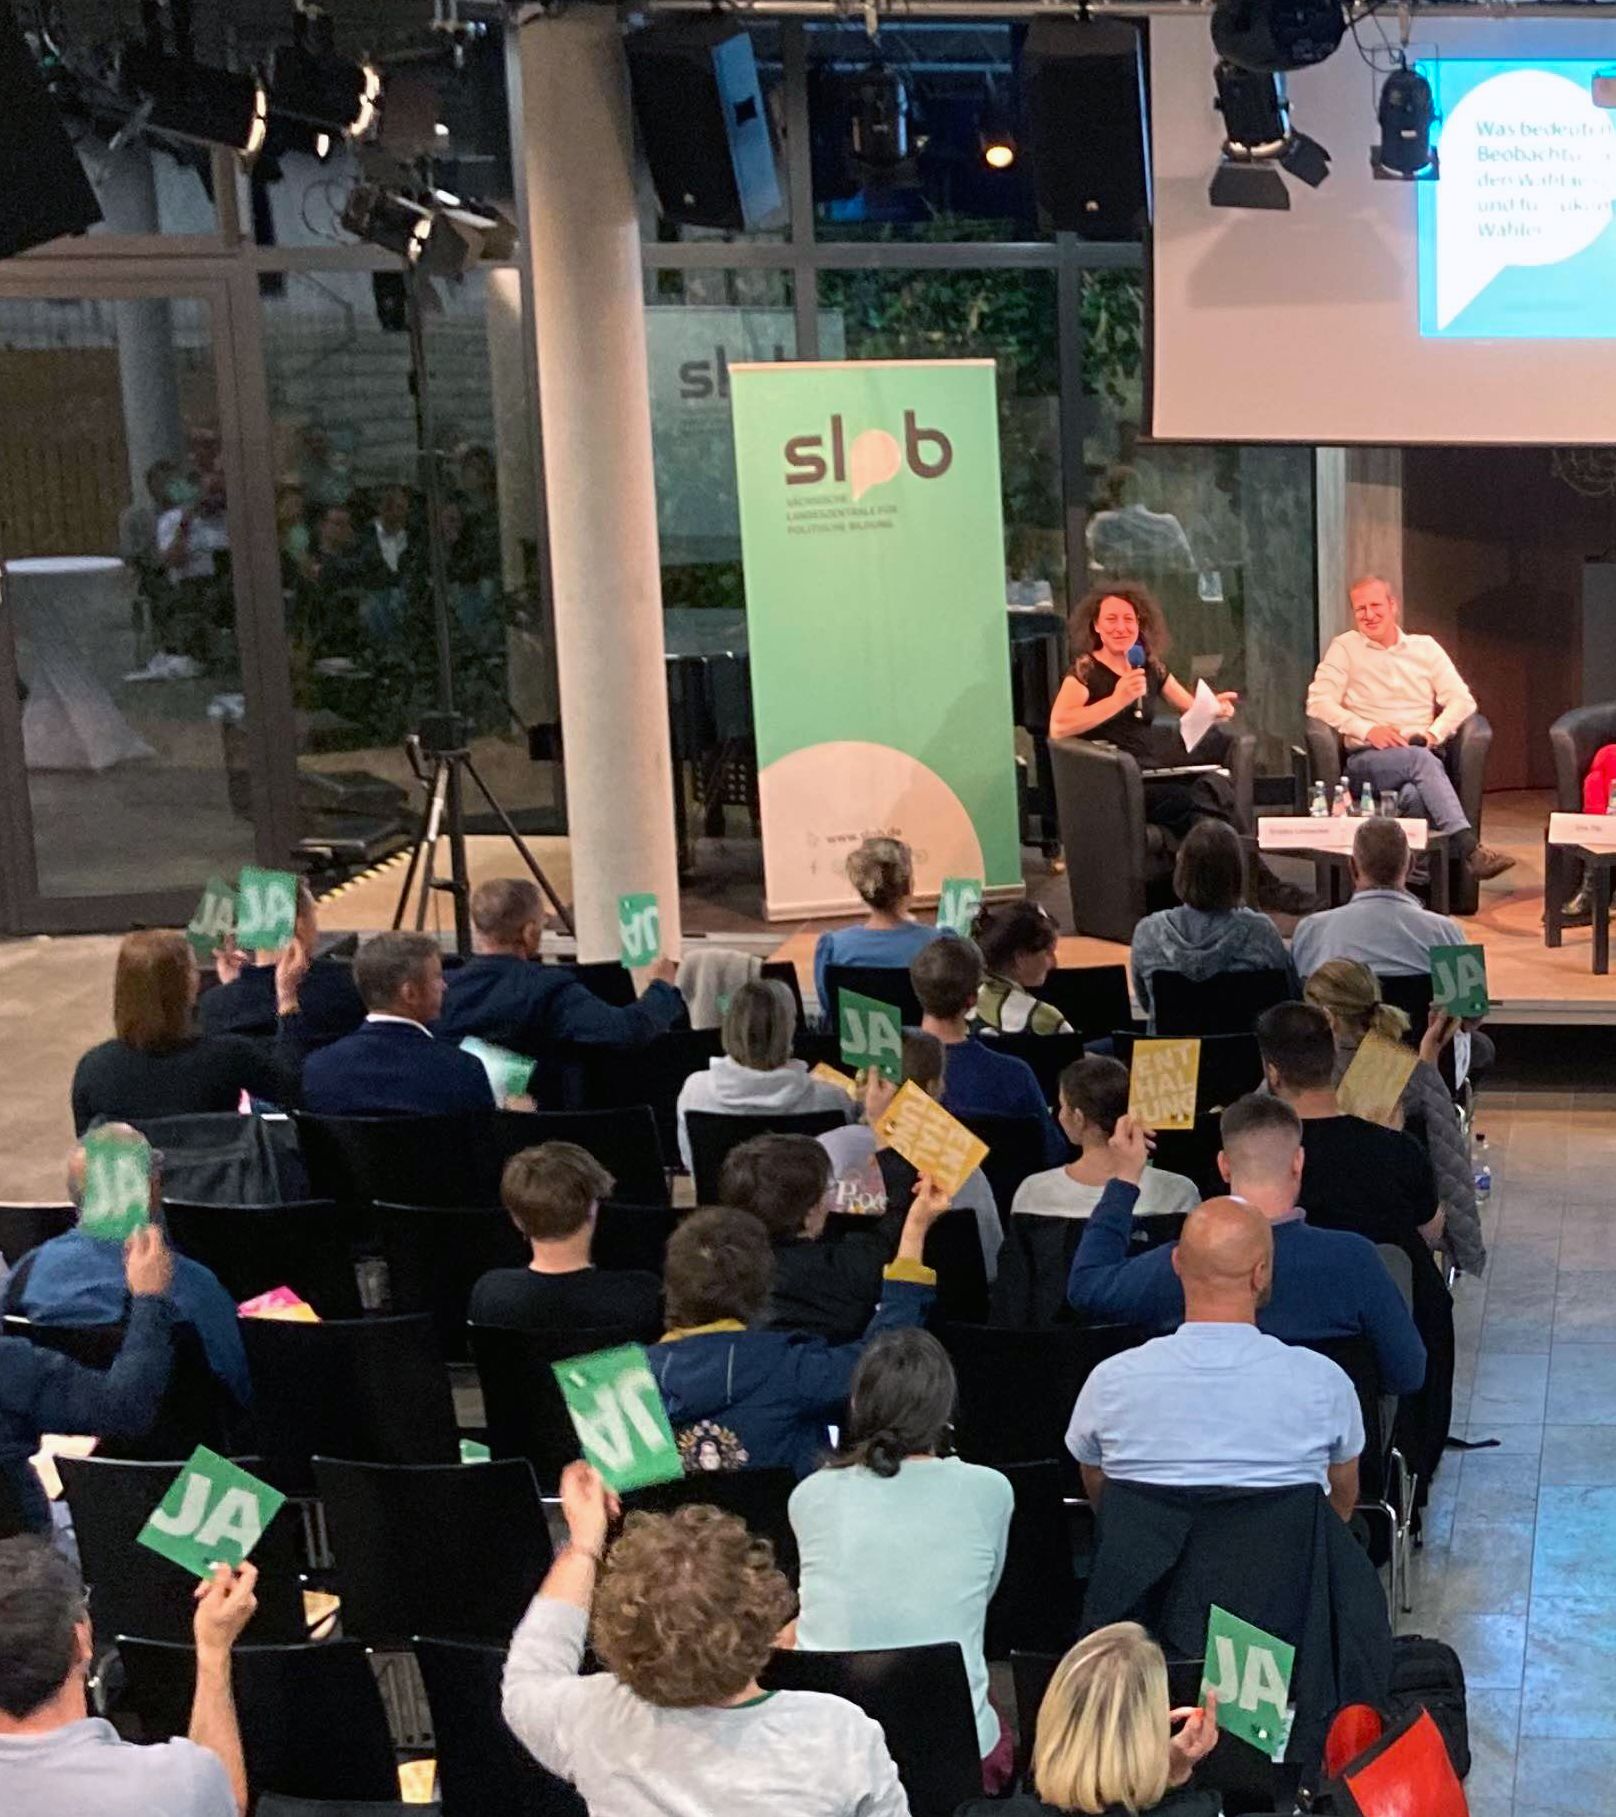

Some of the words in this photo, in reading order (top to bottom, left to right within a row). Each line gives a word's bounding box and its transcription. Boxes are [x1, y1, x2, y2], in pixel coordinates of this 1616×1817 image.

[787, 507, 874, 520] LANDESZENTRALE
[788, 522, 845, 534] POLITISCHE
[850, 520, 893, 530] BILDUNG
[238, 882, 296, 932] JA
[620, 906, 658, 958] JA
[1434, 953, 1485, 1003] JA
[840, 1007, 902, 1058] JA
[577, 1368, 665, 1472] JA
[149, 1473, 263, 1558] JA
[1201, 1635, 1287, 1720] JA
